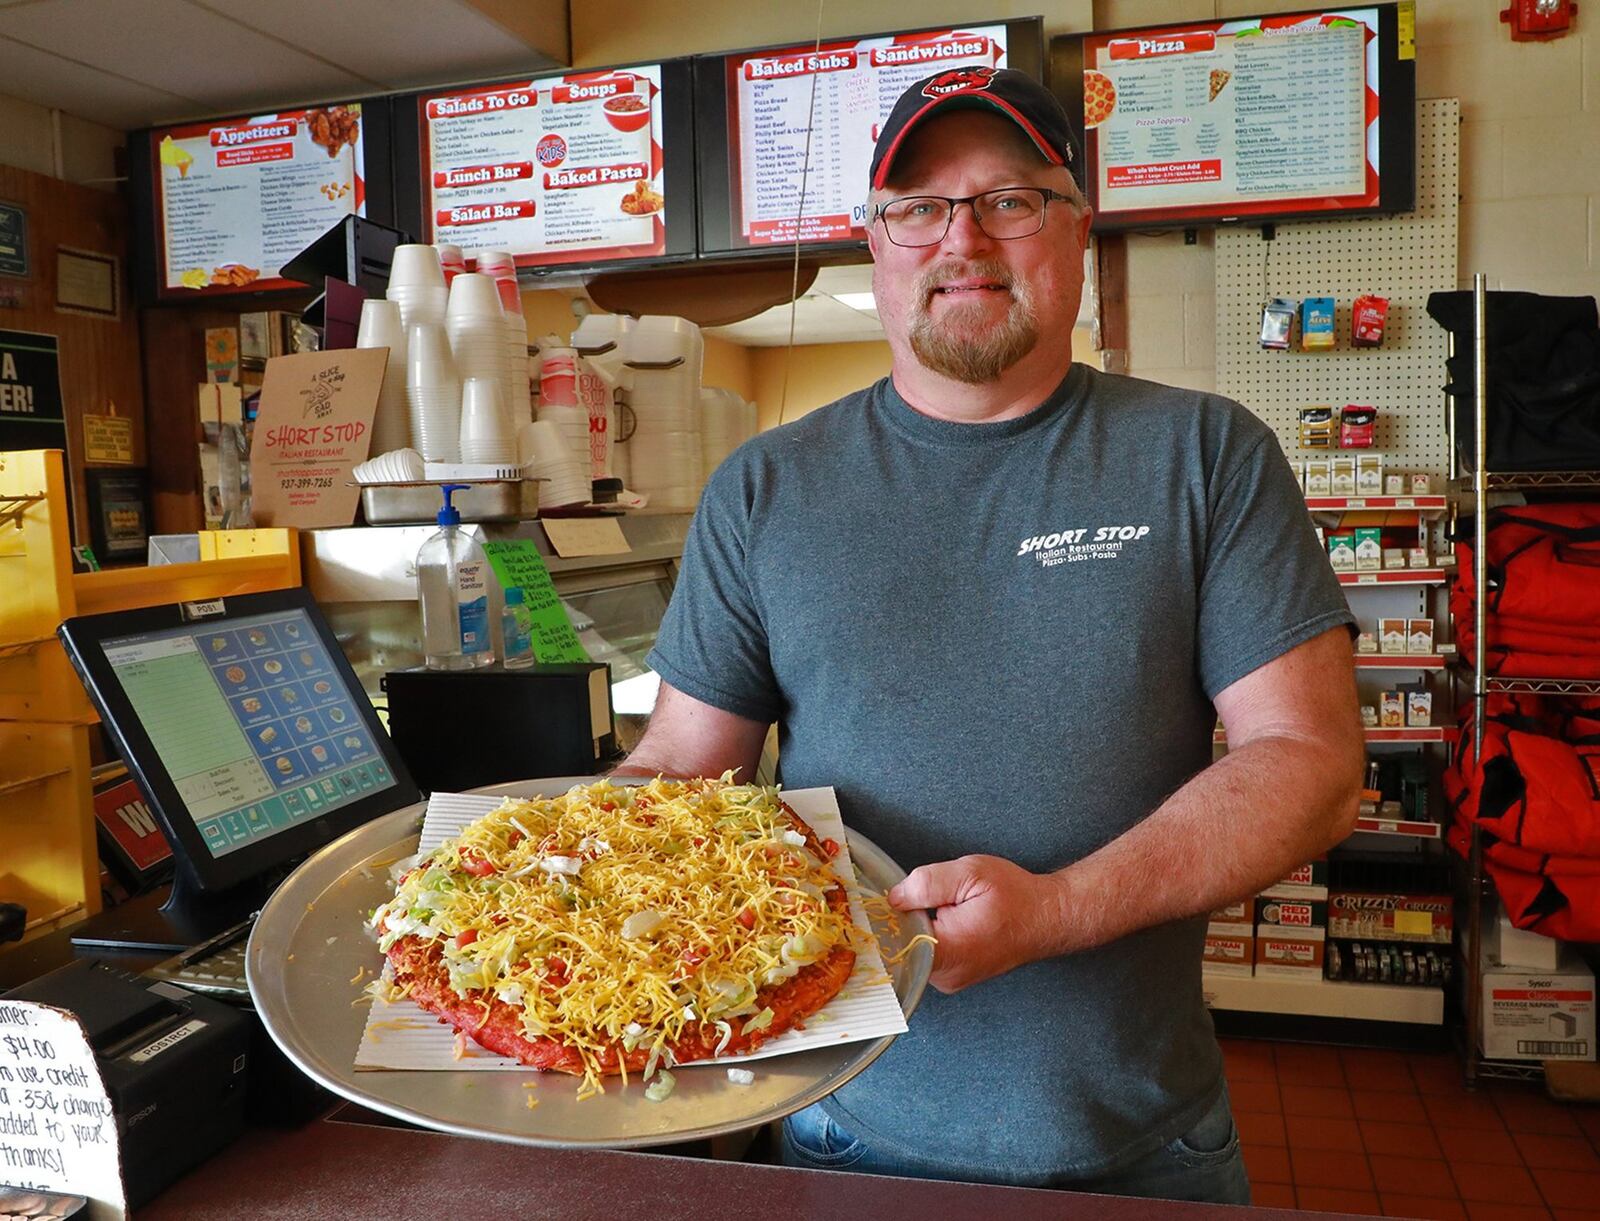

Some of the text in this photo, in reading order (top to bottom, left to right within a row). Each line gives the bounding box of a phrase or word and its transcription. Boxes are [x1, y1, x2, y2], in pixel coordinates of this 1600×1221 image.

[875, 42, 982, 63] Sandwiches
[1138, 40, 1185, 55] Pizza
[751, 54, 850, 77] Baked Subs
[568, 81, 617, 100] Soups
[754, 83, 774, 91] Veggie
[435, 92, 530, 116] Salads To Go
[217, 125, 290, 144] Appetizers
[542, 123, 569, 131] Vegetable
[755, 130, 771, 138] Philly
[537, 144, 566, 162] KIDS
[446, 166, 522, 185] Lunch Bar
[756, 162, 776, 170] Turkey
[549, 166, 644, 187] Baked Pasta
[757, 185, 778, 193] Chicken
[450, 204, 522, 223] Salad Bar
[2, 353, 18, 380] A
[311, 366, 341, 382] A SLICE
[265, 421, 366, 449] SHORT STOP
[279, 447, 345, 459] ITALIAN RESTAURANT
[280, 477, 334, 489] 937-399-7265
[1016, 525, 1150, 557] SHORT STOP
[1035, 541, 1123, 562] Italian Restaurant
[1042, 550, 1118, 568] Pizza Subs Pasta
[1281, 905, 1310, 915] RED
[1333, 896, 1400, 911] GRIZZLY
[1281, 915, 1310, 924] MAN
[1220, 941, 1242, 950] MAN
[1290, 944, 1311, 953] MAN
[1528, 979, 1551, 988] Sysco
[0, 1005, 39, 1027] mer:
[3, 1034, 56, 1060] $4.00
[16, 1066, 44, 1084] use
[46, 1063, 89, 1088] credit
[64, 1093, 113, 1126] charge
[127, 1103, 158, 1128] EPSON
[0, 1111, 38, 1137] added
[45, 1117, 65, 1143] to
[0, 1141, 70, 1184] thanks!
